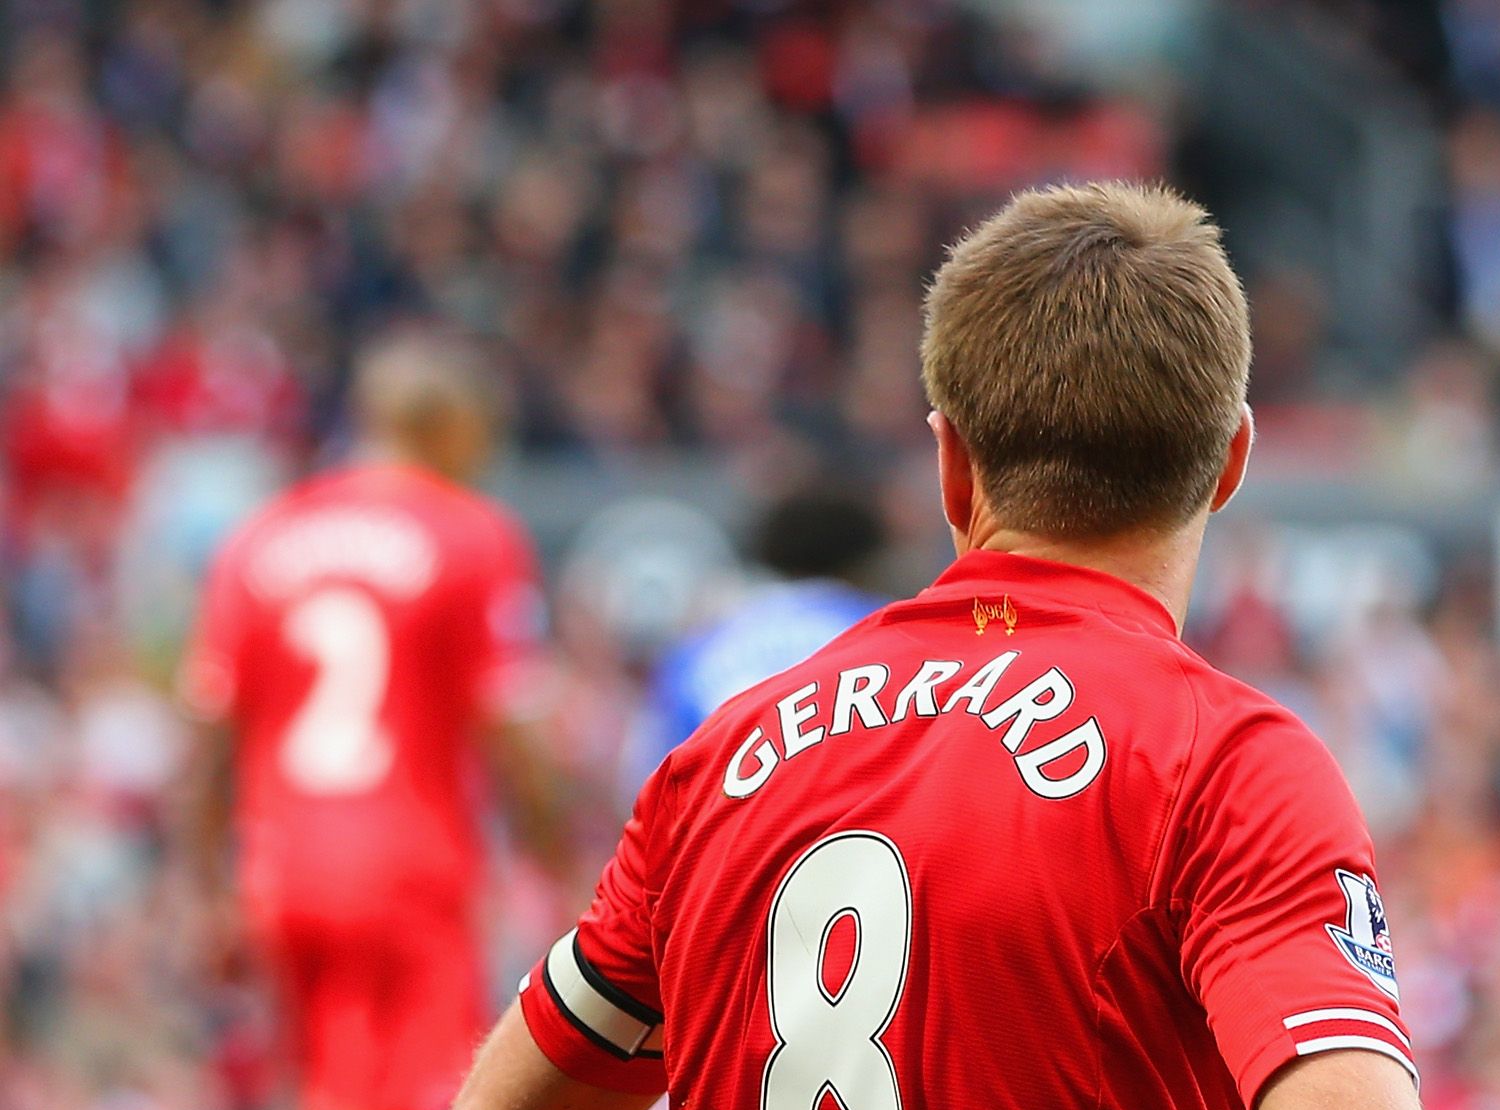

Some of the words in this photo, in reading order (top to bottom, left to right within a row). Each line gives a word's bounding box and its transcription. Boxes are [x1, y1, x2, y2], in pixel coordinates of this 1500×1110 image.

[985, 604, 1004, 620] 96
[281, 586, 396, 794] 2
[722, 650, 1107, 800] GERRARD
